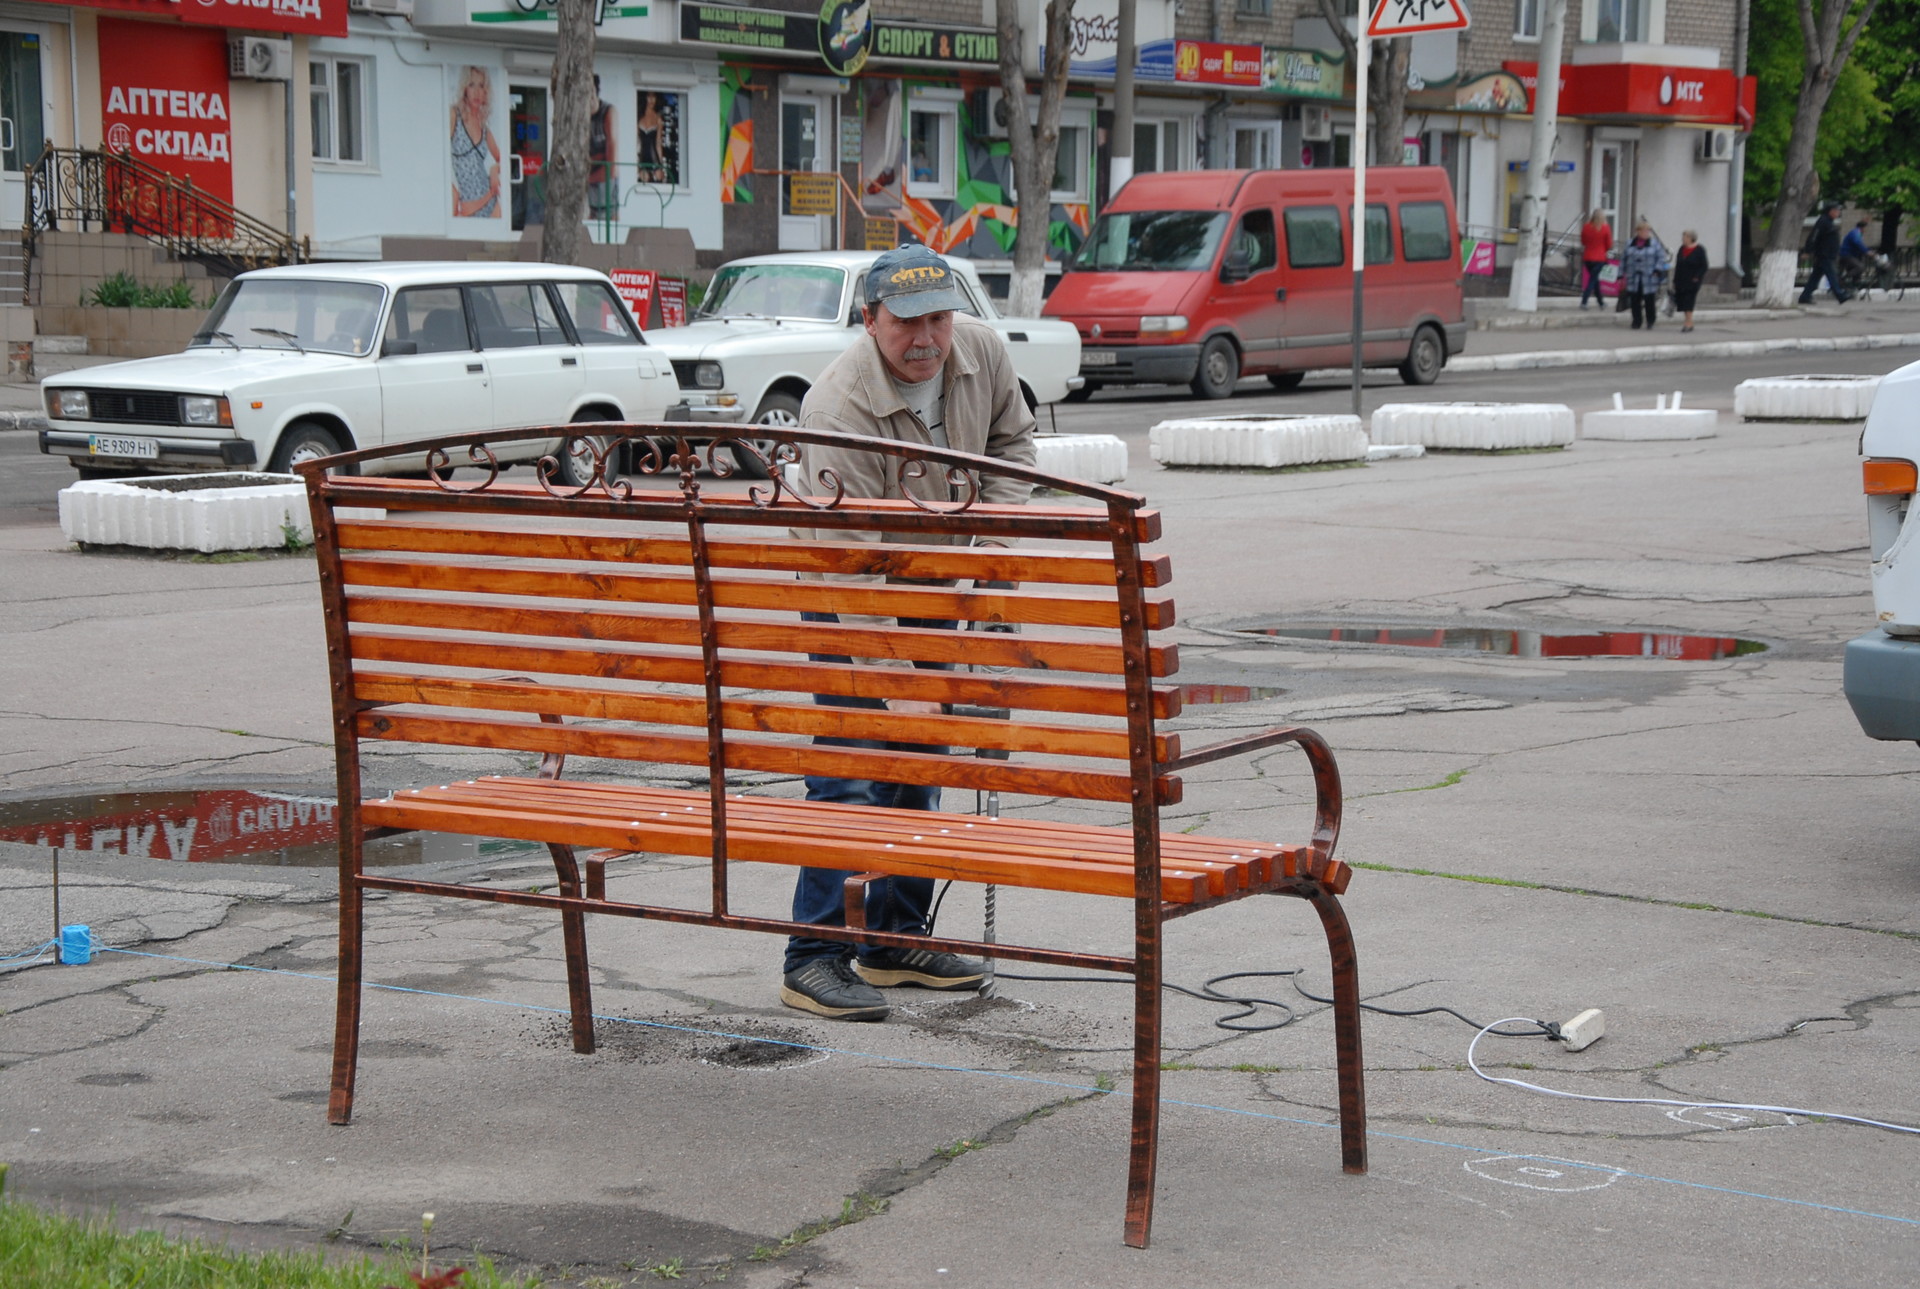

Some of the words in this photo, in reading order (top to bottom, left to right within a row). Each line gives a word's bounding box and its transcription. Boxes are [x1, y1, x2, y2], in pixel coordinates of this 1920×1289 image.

[878, 27, 934, 57] СПОРТ
[939, 34, 951, 58] &
[954, 32, 998, 61] СТИЛ
[1676, 80, 1704, 101] МТС
[106, 86, 227, 120] АПТЕКА
[135, 128, 230, 163] СКЛАД
[611, 273, 650, 286] АПТЕКА
[618, 287, 648, 300] СКЛАД
[97, 439, 109, 453] AE
[111, 440, 135, 455] 9309
